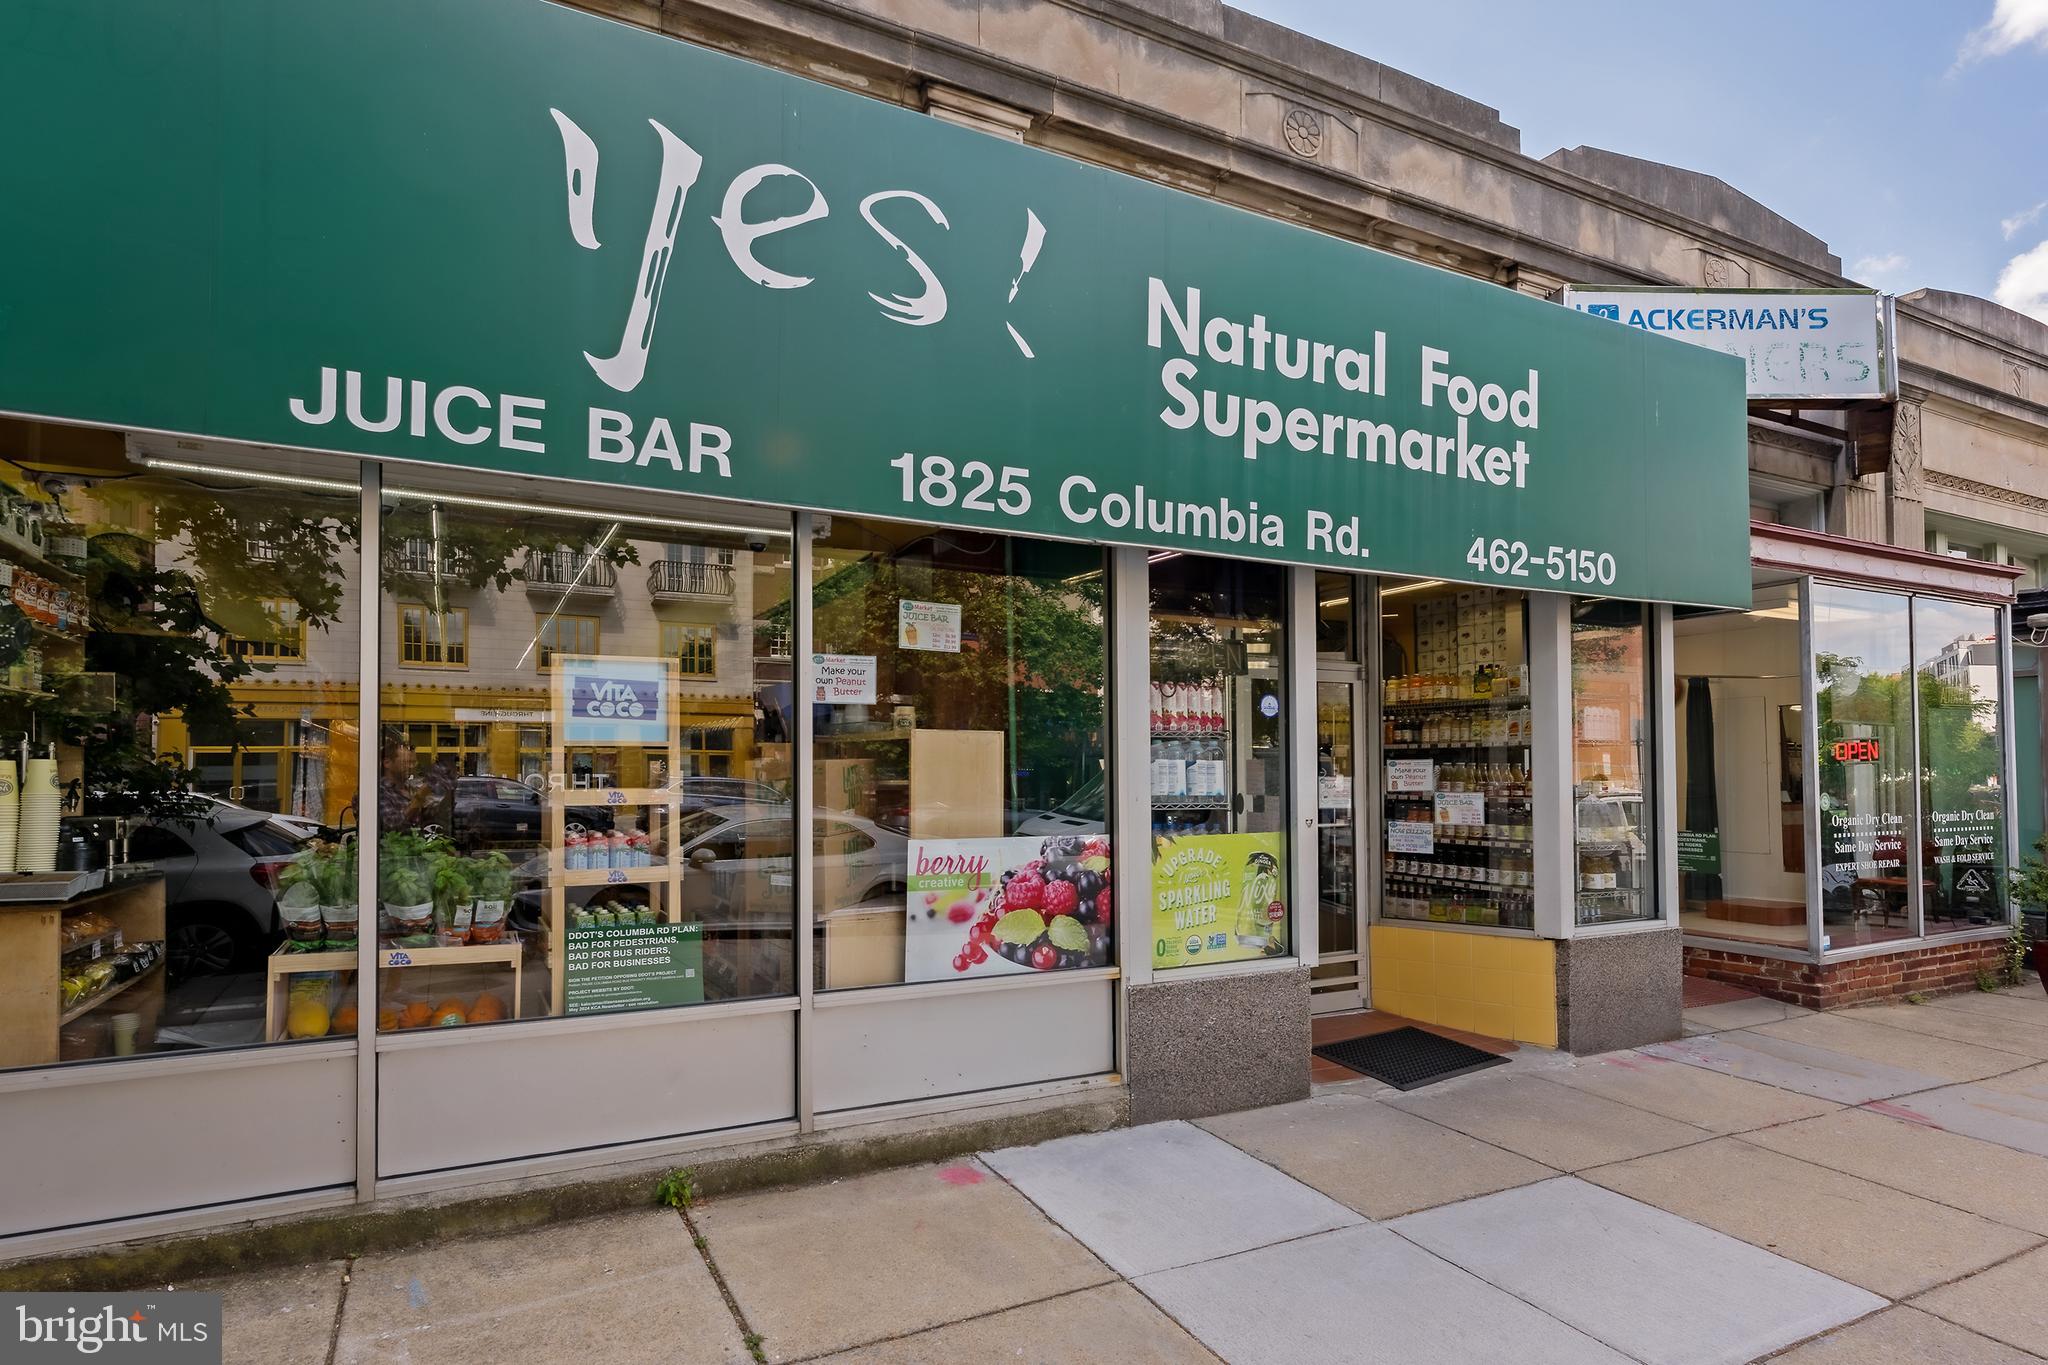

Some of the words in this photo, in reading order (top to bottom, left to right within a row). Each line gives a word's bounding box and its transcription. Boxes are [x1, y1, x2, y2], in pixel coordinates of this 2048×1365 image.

[1627, 307, 1829, 331] ACKERMAN'S
[1147, 276, 1386, 397] Natural
[1421, 345, 1540, 431] Food
[289, 367, 546, 455] JUICE
[588, 407, 733, 478] BAR
[1159, 358, 1531, 490] Supermarket
[890, 452, 1032, 517] 1825
[1059, 474, 1286, 549] Columbia
[1306, 508, 1369, 559] Rd.
[1466, 537, 1617, 587] 462-5150
[902, 611, 929, 621] JUICE
[930, 614, 950, 623] BAR
[821, 666, 846, 675] Make
[847, 668, 866, 676] your
[815, 677, 834, 685] own
[835, 676, 867, 686] Peanut
[590, 680, 639, 702] VITA
[832, 687, 863, 696] Butter
[586, 701, 645, 718] COCO
[1834, 740, 1880, 762] OPEN
[608, 791, 625, 799] VITA
[1831, 813, 1864, 830] Organic
[1865, 813, 1880, 828] Dry
[1881, 812, 1903, 826] Clean
[1931, 810, 1960, 824] Organic
[1961, 809, 1974, 823] Dry
[1975, 808, 1995, 821] Clean
[1834, 840, 1857, 854] Same
[1858, 840, 1873, 855] Day
[1874, 838, 1902, 851] Service
[1934, 835, 1954, 848] Same
[1954, 835, 1968, 848] Day
[1969, 833, 1994, 845] Service
[1161, 847, 1223, 878] UPGRADE
[1835, 860, 1860, 872] EXPERT
[1860, 859, 1878, 870] SHOE
[1878, 858, 1901, 869] REPAIR
[1933, 854, 1951, 865] WASH
[1951, 854, 1956, 863] &
[1956, 853, 1972, 863] FOLD
[1971, 851, 1995, 862] SERVICE
[915, 846, 989, 891] berry
[918, 878, 965, 889] creative
[1158, 879, 1232, 912] SPARKLING
[1174, 904, 1217, 931] WATER
[568, 930, 604, 941] DDOT'S
[606, 927, 655, 939] COLUMBIA
[656, 926, 670, 935] RD
[671, 924, 699, 934] PLAN:
[568, 941, 589, 951] BAD
[591, 940, 611, 949] FOR
[613, 936, 679, 948] PEDESTRIANS,
[1156, 938, 1166, 957] 0
[390, 951, 409, 960] VITA
[568, 951, 589, 961] BAD
[591, 950, 611, 959] FOR
[613, 948, 633, 958] BUS
[634, 946, 671, 956] RIDERS,
[568, 962, 589, 971] BAD
[591, 960, 611, 970] FOR
[613, 956, 671, 968] BUSINESSES
